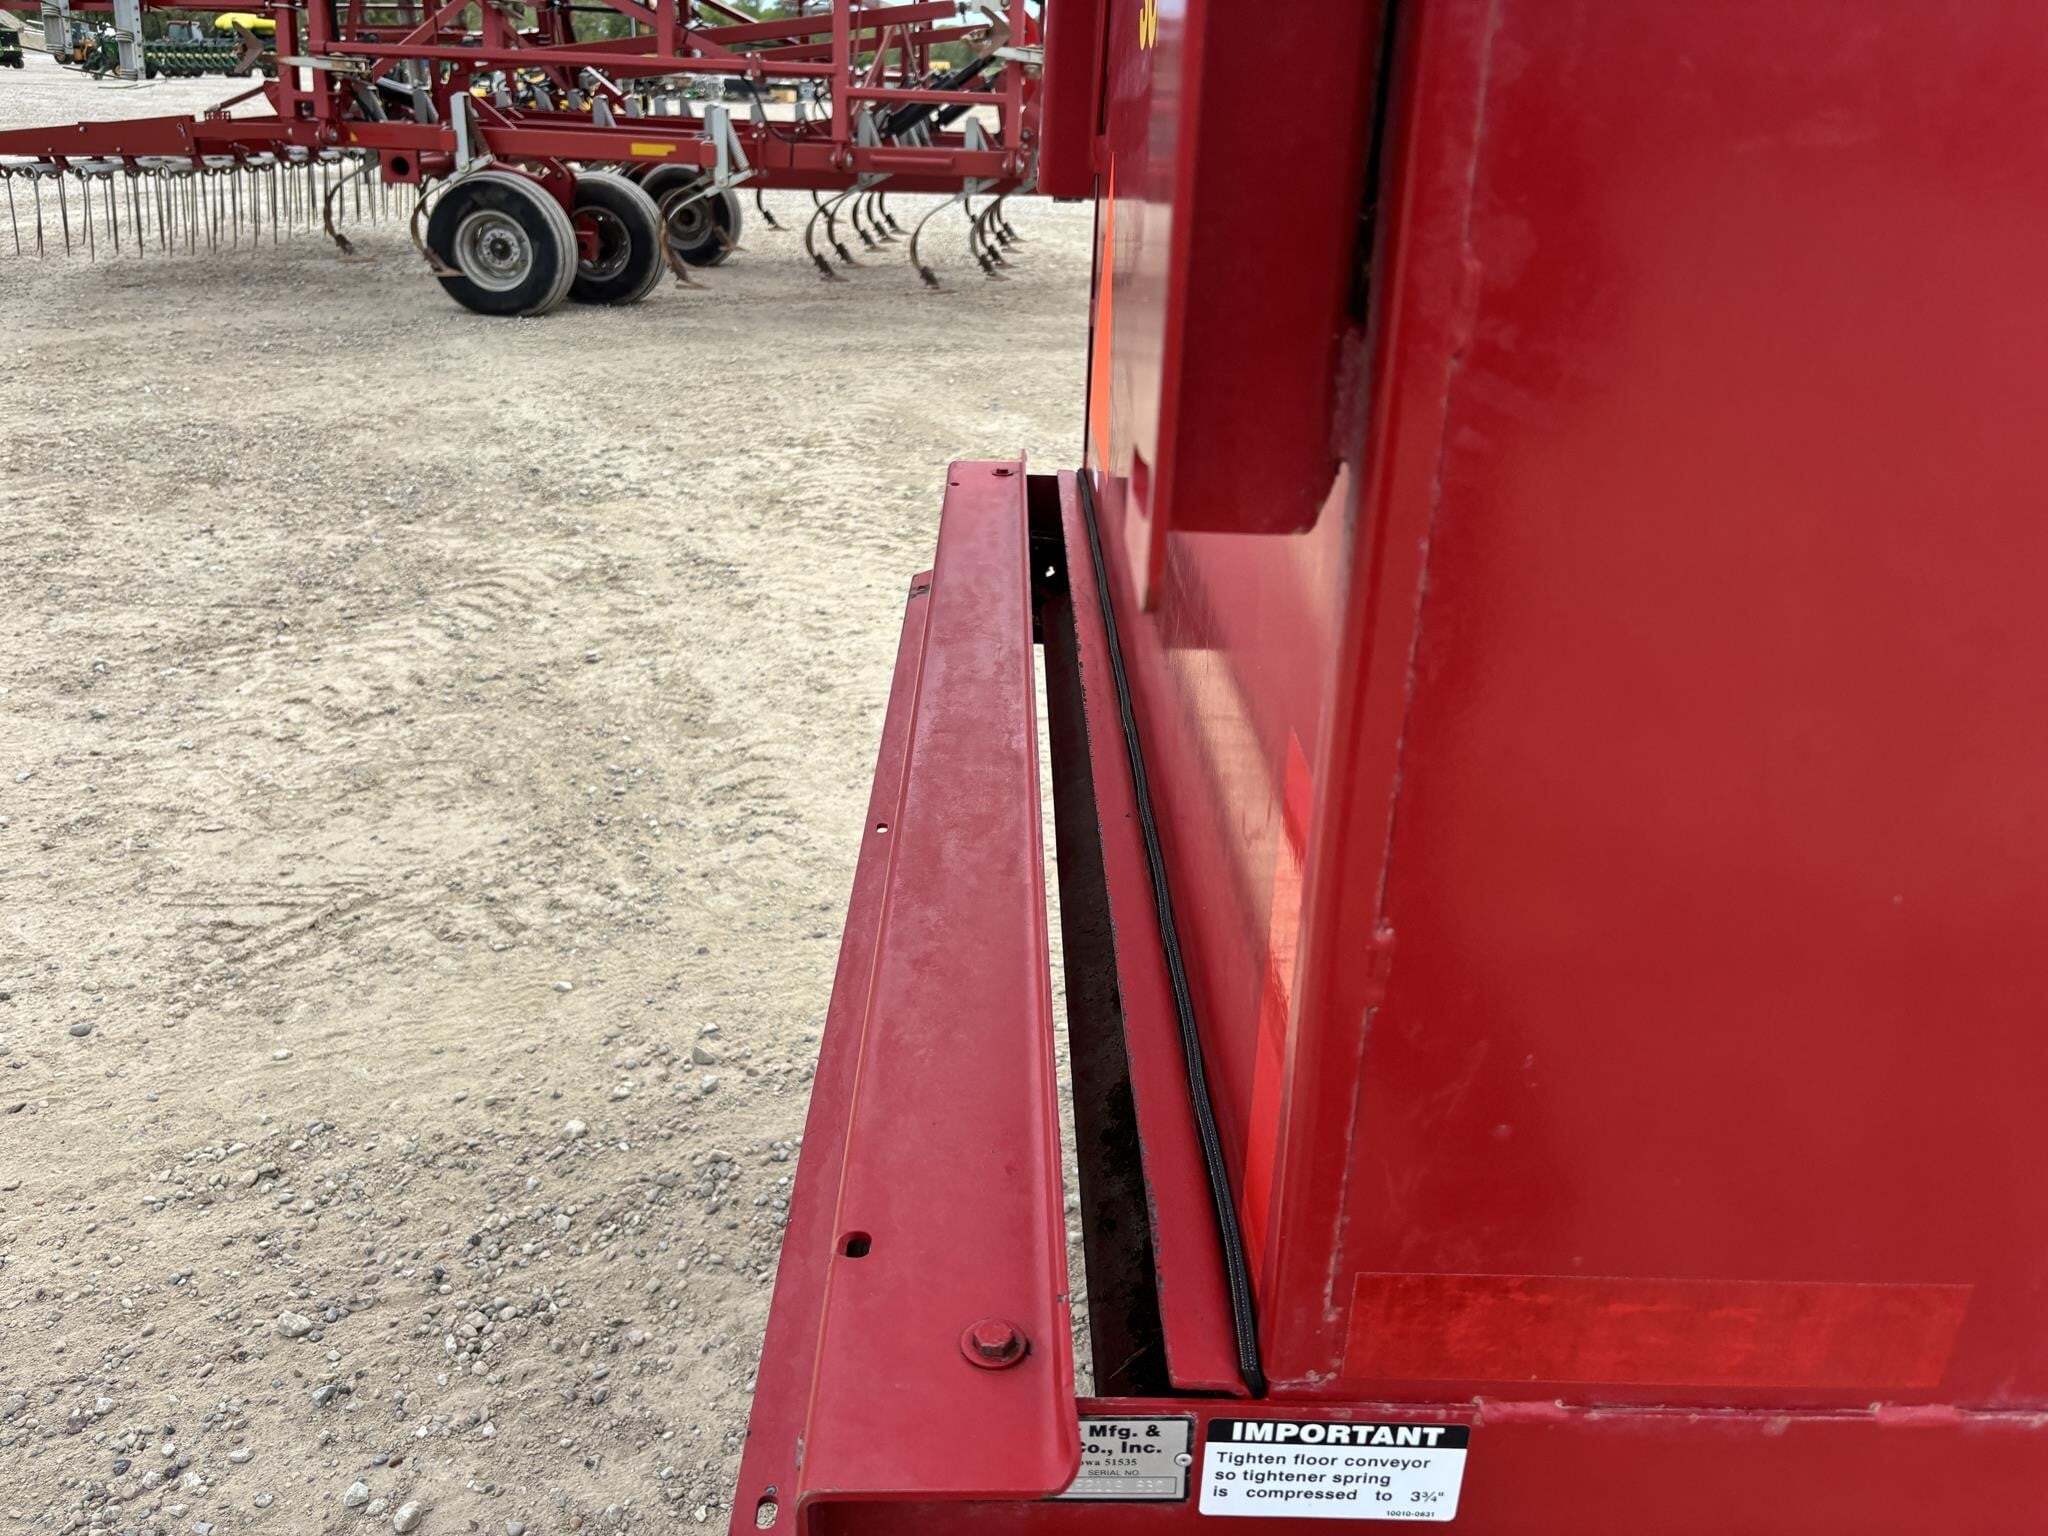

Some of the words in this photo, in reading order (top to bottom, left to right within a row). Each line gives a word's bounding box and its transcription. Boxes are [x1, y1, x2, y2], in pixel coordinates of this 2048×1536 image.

[1089, 1424, 1138, 1440] Mfg.
[1145, 1424, 1161, 1438] &
[1232, 1421, 1446, 1447] IMPORTANT
[1121, 1441, 1162, 1454] Inc.
[1105, 1458, 1139, 1467] 51535
[1216, 1451, 1287, 1467] Tighten
[1294, 1453, 1338, 1466] floor
[1344, 1456, 1432, 1471] conveyor
[1087, 1469, 1121, 1477] SERIAL
[1214, 1471, 1237, 1481] so
[1243, 1469, 1327, 1484] tightener
[1332, 1472, 1392, 1487] spring
[1213, 1485, 1228, 1497] is
[1246, 1487, 1358, 1501] compressed
[1375, 1490, 1393, 1502] to
